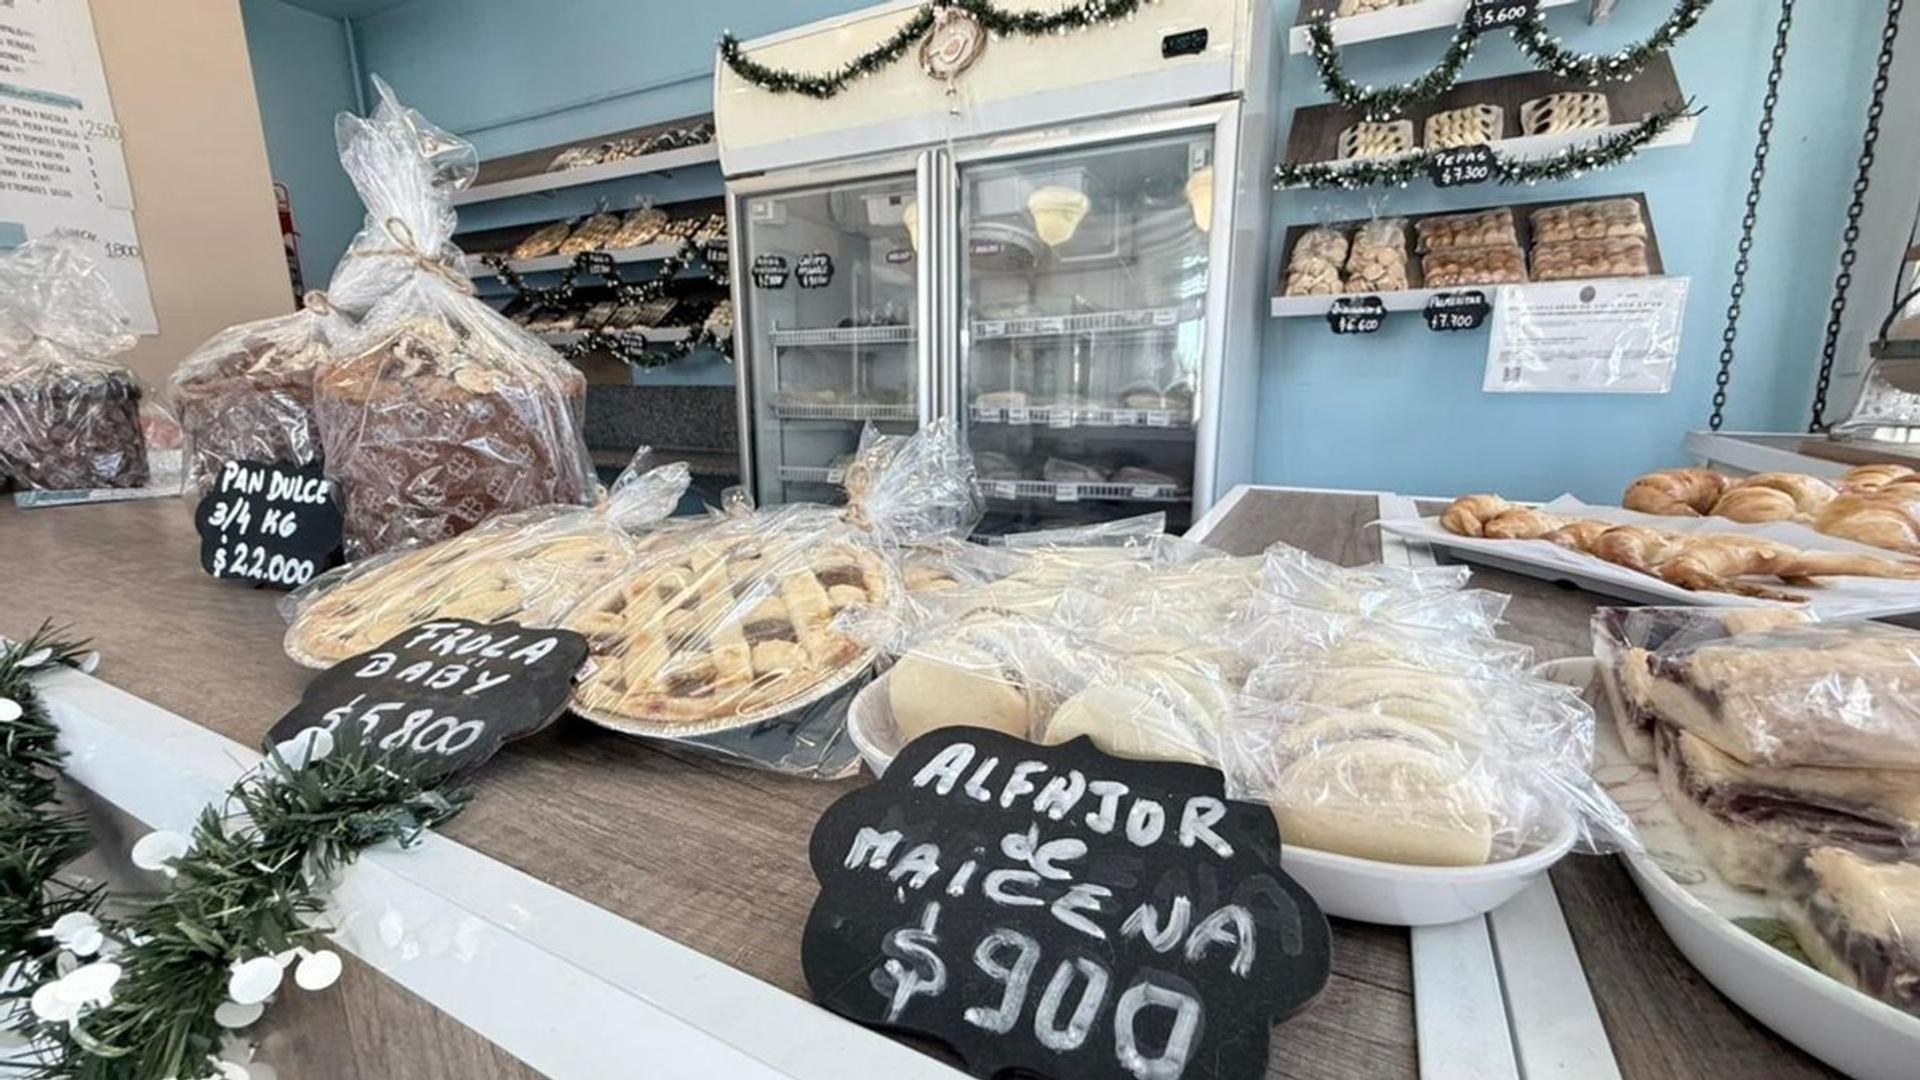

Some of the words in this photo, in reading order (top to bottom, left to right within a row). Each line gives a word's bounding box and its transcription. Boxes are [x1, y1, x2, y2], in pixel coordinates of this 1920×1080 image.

[1473, 5, 1527, 27] $5.600
[1435, 151, 1486, 167] PEPAS
[1442, 165, 1488, 184] $7.300
[221, 460, 265, 494] PAN
[266, 470, 330, 504] DULCE
[208, 497, 251, 535] 3/4
[260, 508, 298, 538] KG
[213, 534, 314, 585] $22.000
[404, 622, 558, 665] FROLA
[354, 652, 511, 695] BABY
[912, 742, 1234, 858] ALFAJOR
[1000, 821, 1088, 881] de
[843, 826, 1258, 980] MAICENA
[880, 900, 1202, 1080] $900
